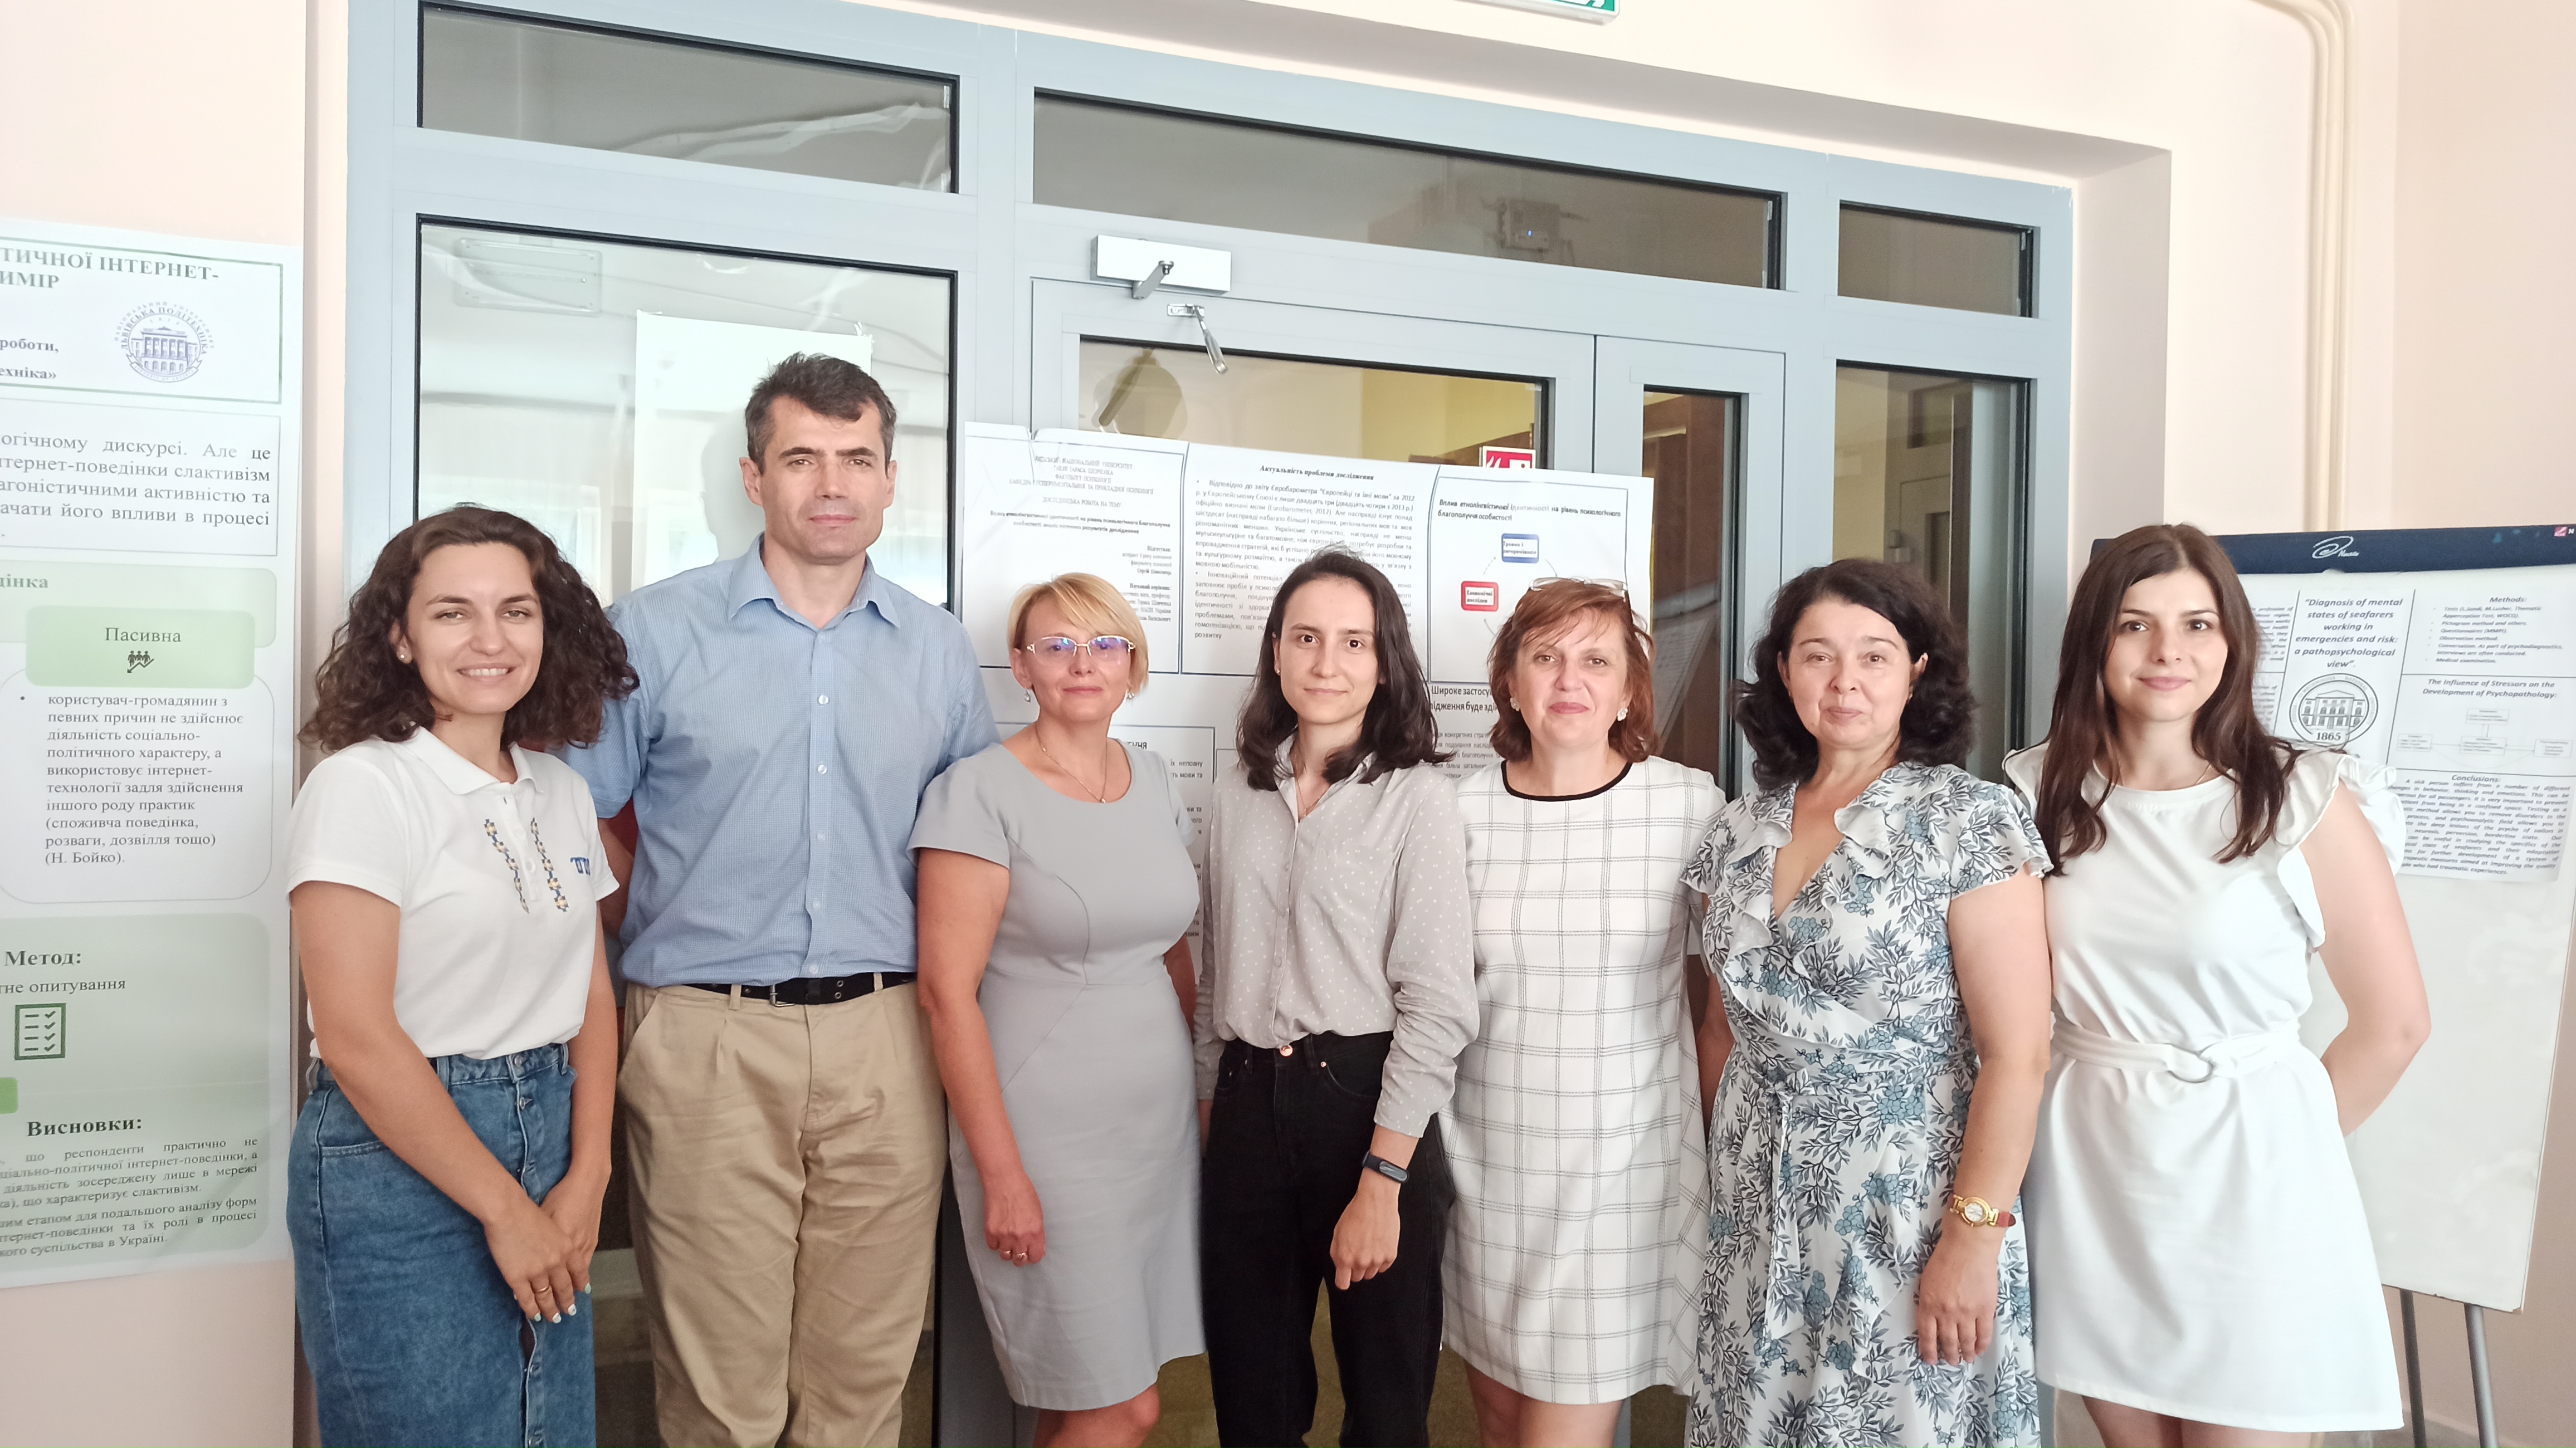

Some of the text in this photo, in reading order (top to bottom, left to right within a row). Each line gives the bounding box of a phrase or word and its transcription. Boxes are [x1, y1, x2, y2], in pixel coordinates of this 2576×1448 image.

[100, 257, 219, 280] ІНТЕРНЕТ-
[121, 307, 208, 354] ЛЬВІВСЬКА ПОЛІТЕХНІКА
[0, 435, 271, 461] огічному дискурсі. Але це
[174, 467, 270, 481] слактивізм
[1260, 465, 1303, 474] Актуальність
[144, 487, 246, 502] активністю
[252, 493, 270, 503] та
[1439, 499, 1457, 507] Вплив
[1561, 506, 1578, 515] рівень
[61, 503, 103, 518] його
[111, 509, 177, 521] впливи
[185, 513, 194, 522] в
[203, 511, 269, 527] процесі
[1479, 513, 1512, 522] особистості
[2356, 599, 2367, 607] of
[2338, 611, 2349, 619] of
[2350, 611, 2394, 619] seafarers
[105, 628, 182, 642] Пасивна
[2295, 635, 2354, 644] emergencies
[2302, 648, 2396, 657] pathopsychological
[1431, 685, 1462, 697] Широке
[48, 697, 217, 708] користувач-громадянин
[1466, 701, 1483, 712] буде
[47, 714, 99, 722] певних
[104, 715, 156, 726] причин
[180, 712, 243, 725] здійснює
[47, 728, 201, 742] діяльність соціально-
[47, 746, 135, 757] політичного
[139, 750, 210, 761] характеру,
[47, 764, 213, 778] використовує інтернет-
[46, 781, 243, 794] технології задля здійснення
[47, 799, 195, 813] іншого роду практик
[46, 816, 198, 830] (споживча поведінка,
[46, 834, 216, 849] розваги, дозвілля тощо)
[46, 852, 125, 865] (Н. Бойко).
[4, 951, 81, 967] Метод:
[29, 981, 126, 994] опитування
[27, 1119, 142, 1136] Висновки:
[64, 1146, 144, 1161] респонденти
[163, 1138, 226, 1153] практично
[245, 1138, 258, 1146] не
[3, 1180, 70, 1194] діяльність
[78, 1173, 156, 1188] зосереджену
[163, 1172, 196, 1180] лише
[217, 1165, 257, 1176] мережі
[46, 1191, 128, 1206] характеризує
[102, 1206, 174, 1220] подальшого
[179, 1200, 222, 1213] аналізу
[226, 1198, 256, 1210] форм
[143, 1221, 154, 1229] їх
[164, 1219, 187, 1230] ролі
[212, 1211, 256, 1225] процесі
